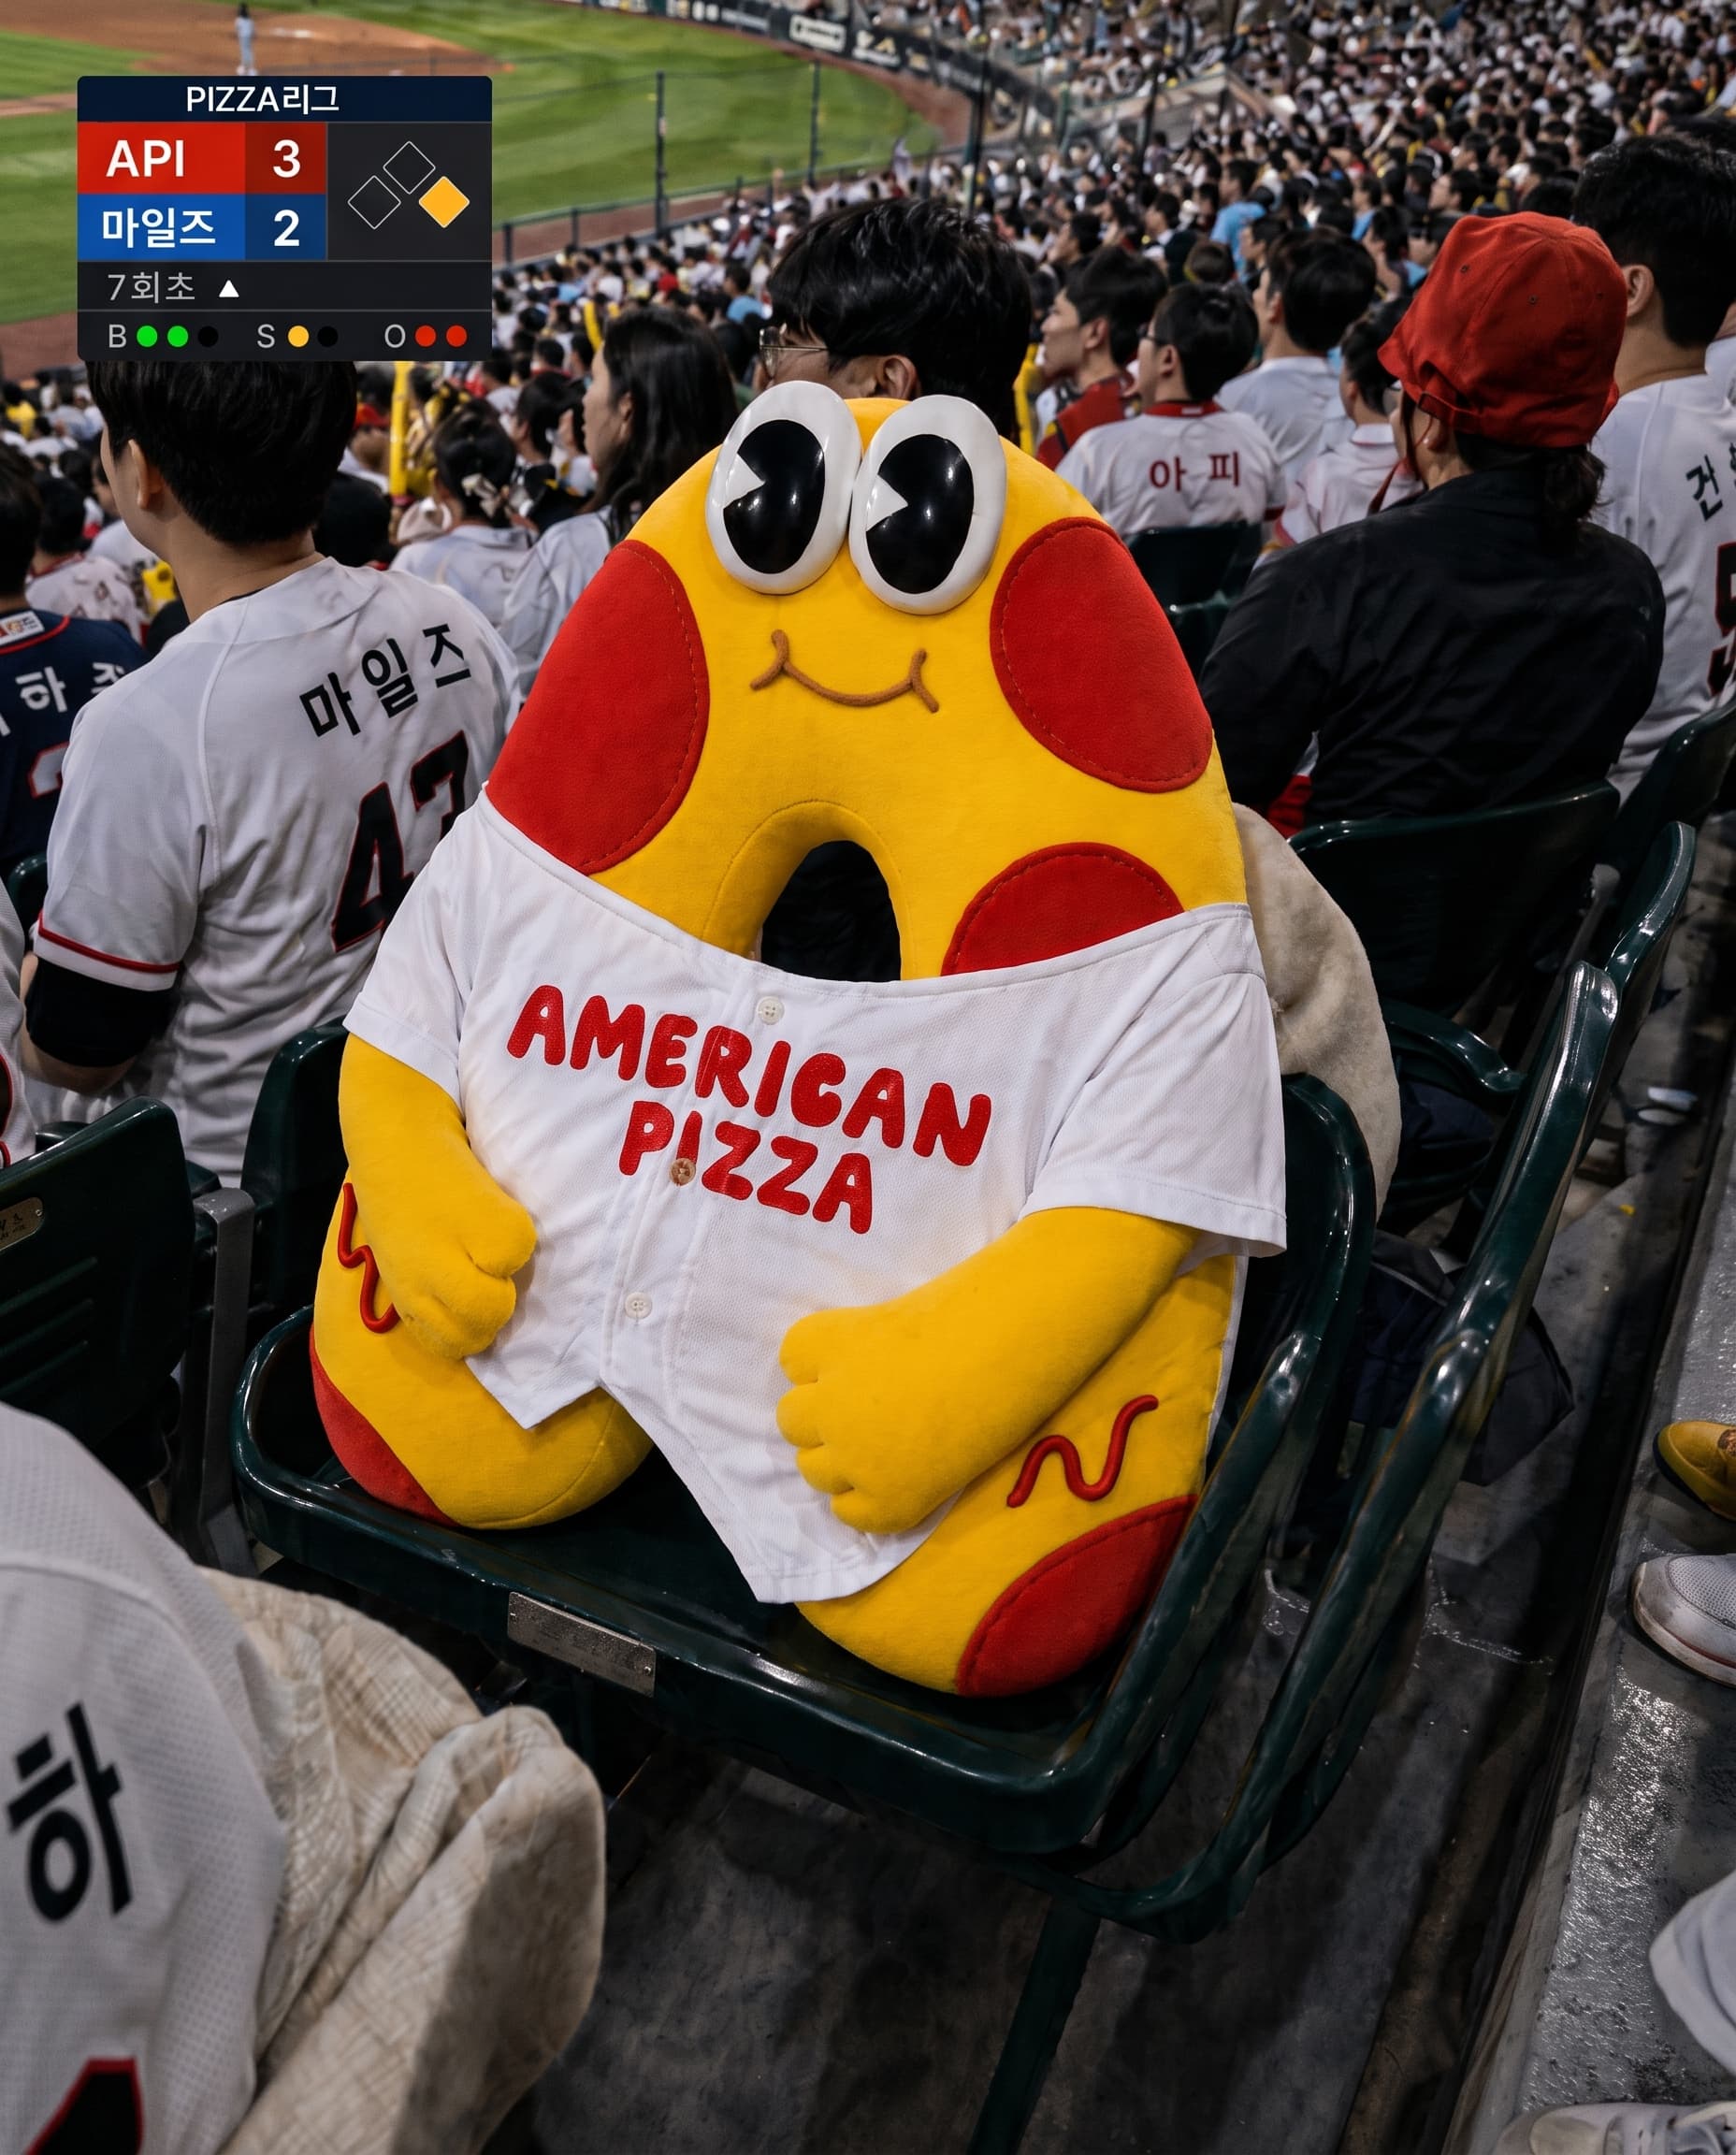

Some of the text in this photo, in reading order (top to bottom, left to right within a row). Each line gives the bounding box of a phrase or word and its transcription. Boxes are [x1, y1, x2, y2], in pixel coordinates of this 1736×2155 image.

[1685, 442, 1736, 522] 건
[299, 623, 472, 737] 마일즈
[506, 984, 992, 1167] AMERICAN
[618, 1100, 873, 1235] PIZZA
